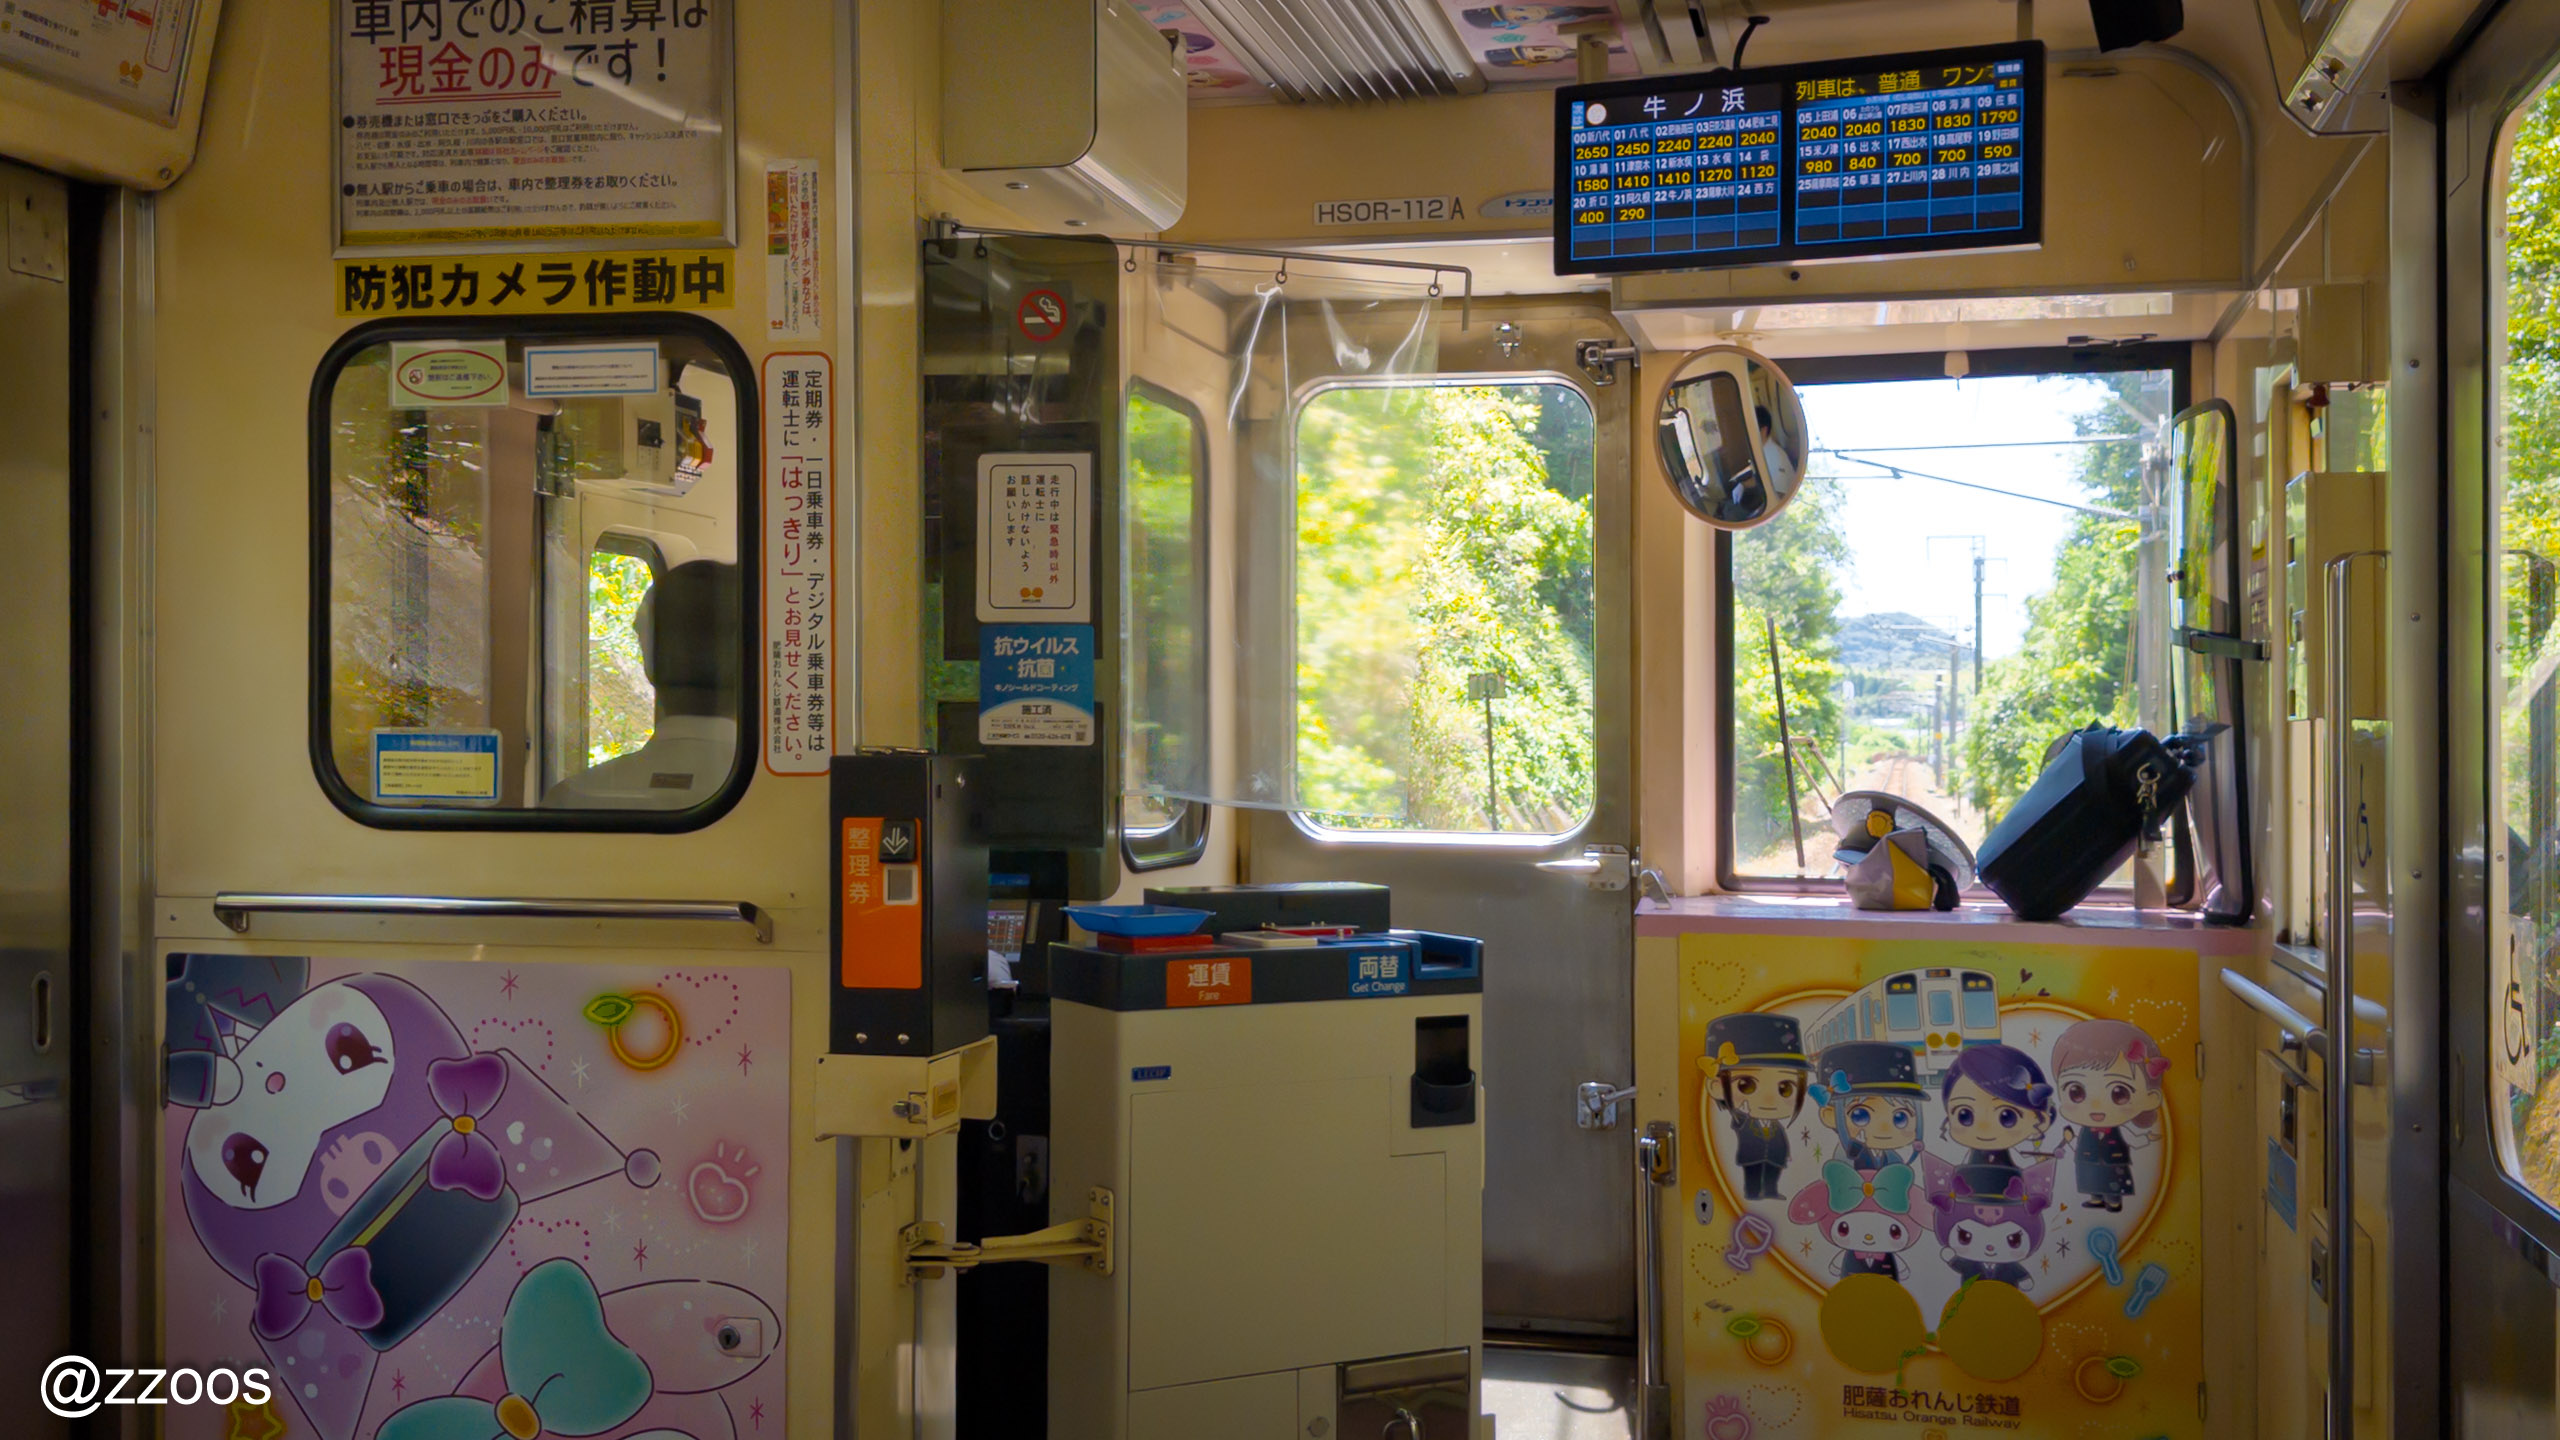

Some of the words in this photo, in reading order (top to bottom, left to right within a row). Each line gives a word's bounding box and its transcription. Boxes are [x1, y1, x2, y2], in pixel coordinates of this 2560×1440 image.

[1799, 112, 1813, 124] 05
[1842, 108, 1857, 120] 06
[1887, 104, 1902, 116] 07
[1932, 100, 1947, 112] 08
[1977, 95, 1992, 108] 09
[1573, 132, 1587, 144] 00
[1614, 129, 1626, 141] 01
[1655, 125, 1669, 137] 02
[1696, 121, 1711, 133] 03
[1738, 118, 1752, 130] 04
[1801, 125, 1837, 141] 2040
[1845, 122, 1881, 137] 2040
[1891, 117, 1926, 132] 1830
[1936, 113, 1971, 129] 1830
[1982, 109, 2018, 124] 1790
[1576, 146, 1609, 160] 2650
[1616, 142, 1650, 157] 2450
[1657, 138, 1691, 153] 2240
[1698, 135, 1733, 149] 2240
[1740, 131, 1775, 146] 2040
[1799, 145, 1813, 157] 15
[1843, 141, 1857, 154] 16
[1888, 137, 1901, 150] 17
[1933, 134, 1946, 146] 18
[1978, 130, 1992, 142] 19
[1575, 164, 1587, 176] 10
[1615, 161, 1626, 173] 11
[1655, 158, 1668, 169] 12
[1696, 154, 1709, 166] 13
[1739, 151, 1752, 162] 14
[1805, 159, 1833, 174] 980
[1849, 156, 1877, 170] 840
[1893, 152, 1922, 166] 700
[1938, 148, 1966, 162] 700
[1984, 144, 2013, 159] 590
[1577, 178, 1609, 192] 1580
[1617, 175, 1650, 188] 1410
[1658, 171, 1691, 185] 1410
[1699, 168, 1733, 182] 1270
[1741, 164, 1775, 179] 1120
[1799, 178, 1814, 191] 25
[1842, 175, 1857, 187] 26
[1887, 171, 1901, 184] 27
[1901, 170, 1928, 183] 上川内
[1932, 168, 1946, 181] 28
[1948, 166, 1970, 179] 川内
[1977, 164, 1992, 177] 29
[1573, 197, 1587, 209] 20
[1614, 193, 1626, 206] 21
[1655, 190, 1668, 202] 22
[1696, 187, 1711, 199] 23
[1738, 184, 1751, 196] 24
[1754, 182, 1774, 194] 西方
[1579, 210, 1605, 224] 400
[1619, 207, 1646, 221] 290
[344, 255, 725, 312] 防犯カメラ作動中
[994, 636, 1079, 656] 抗ウイルス
[849, 827, 871, 905] 整理券
[1187, 962, 1232, 988] 運賃
[1359, 955, 1400, 980] 両替
[1198, 989, 1221, 1000] Fare
[1352, 982, 1369, 994] Get
[1370, 979, 1406, 994] Change
[1842, 1384, 2021, 1418] 肥薩おれんじ鉄道
[1842, 1406, 1897, 1422] Hisatsu
[1903, 1410, 1957, 1427] Orange
[1961, 1413, 2022, 1431] Railway
